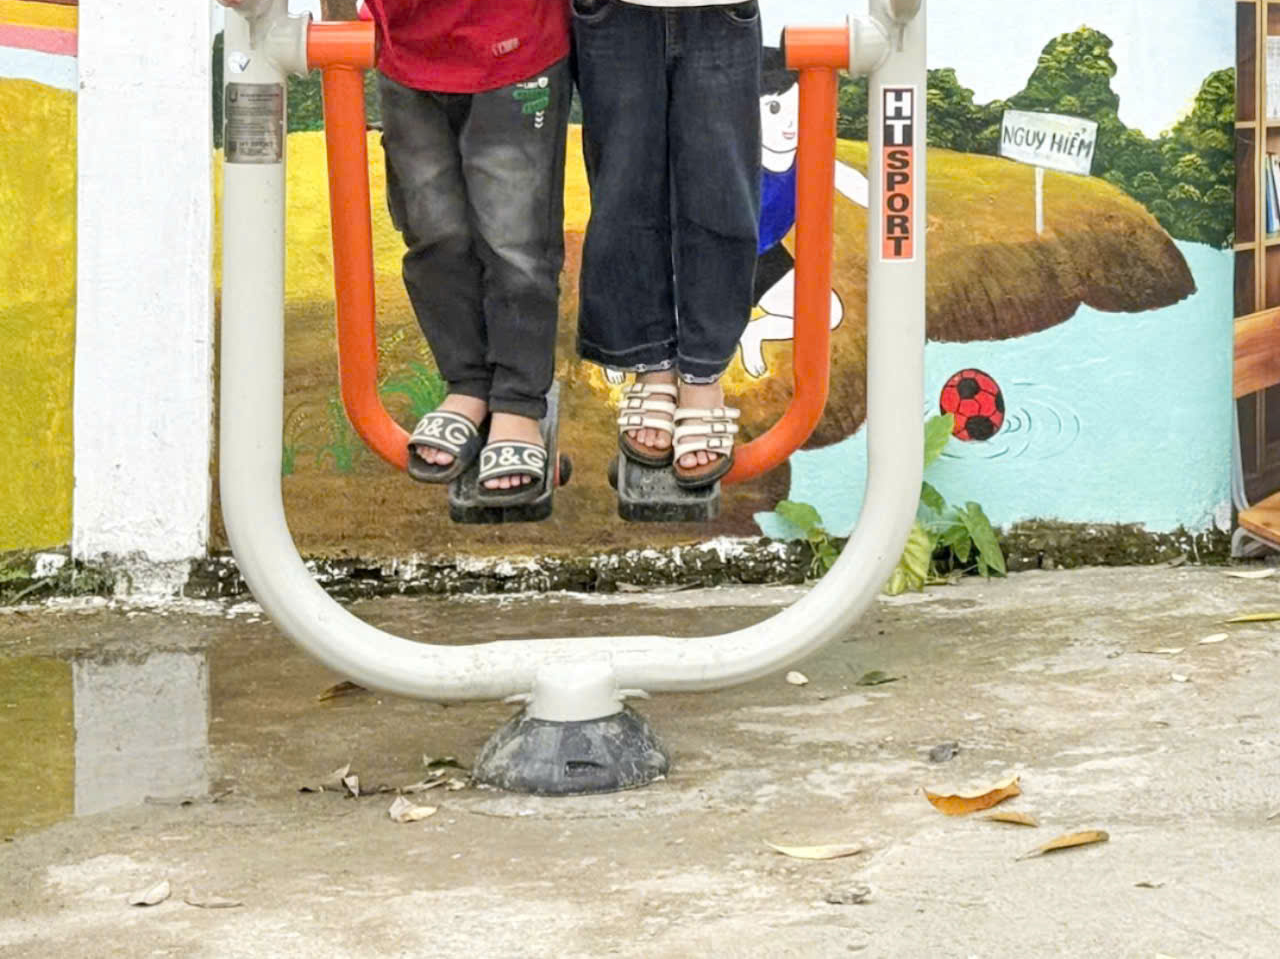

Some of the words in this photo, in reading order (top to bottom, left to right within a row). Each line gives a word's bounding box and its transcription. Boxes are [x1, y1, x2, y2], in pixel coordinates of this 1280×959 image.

[885, 91, 912, 145] HT
[1003, 125, 1047, 151] NGUY
[1050, 127, 1093, 159] HIỂM
[886, 150, 910, 257] SPORT
[413, 417, 470, 445] D&G
[480, 446, 545, 472] D&G
